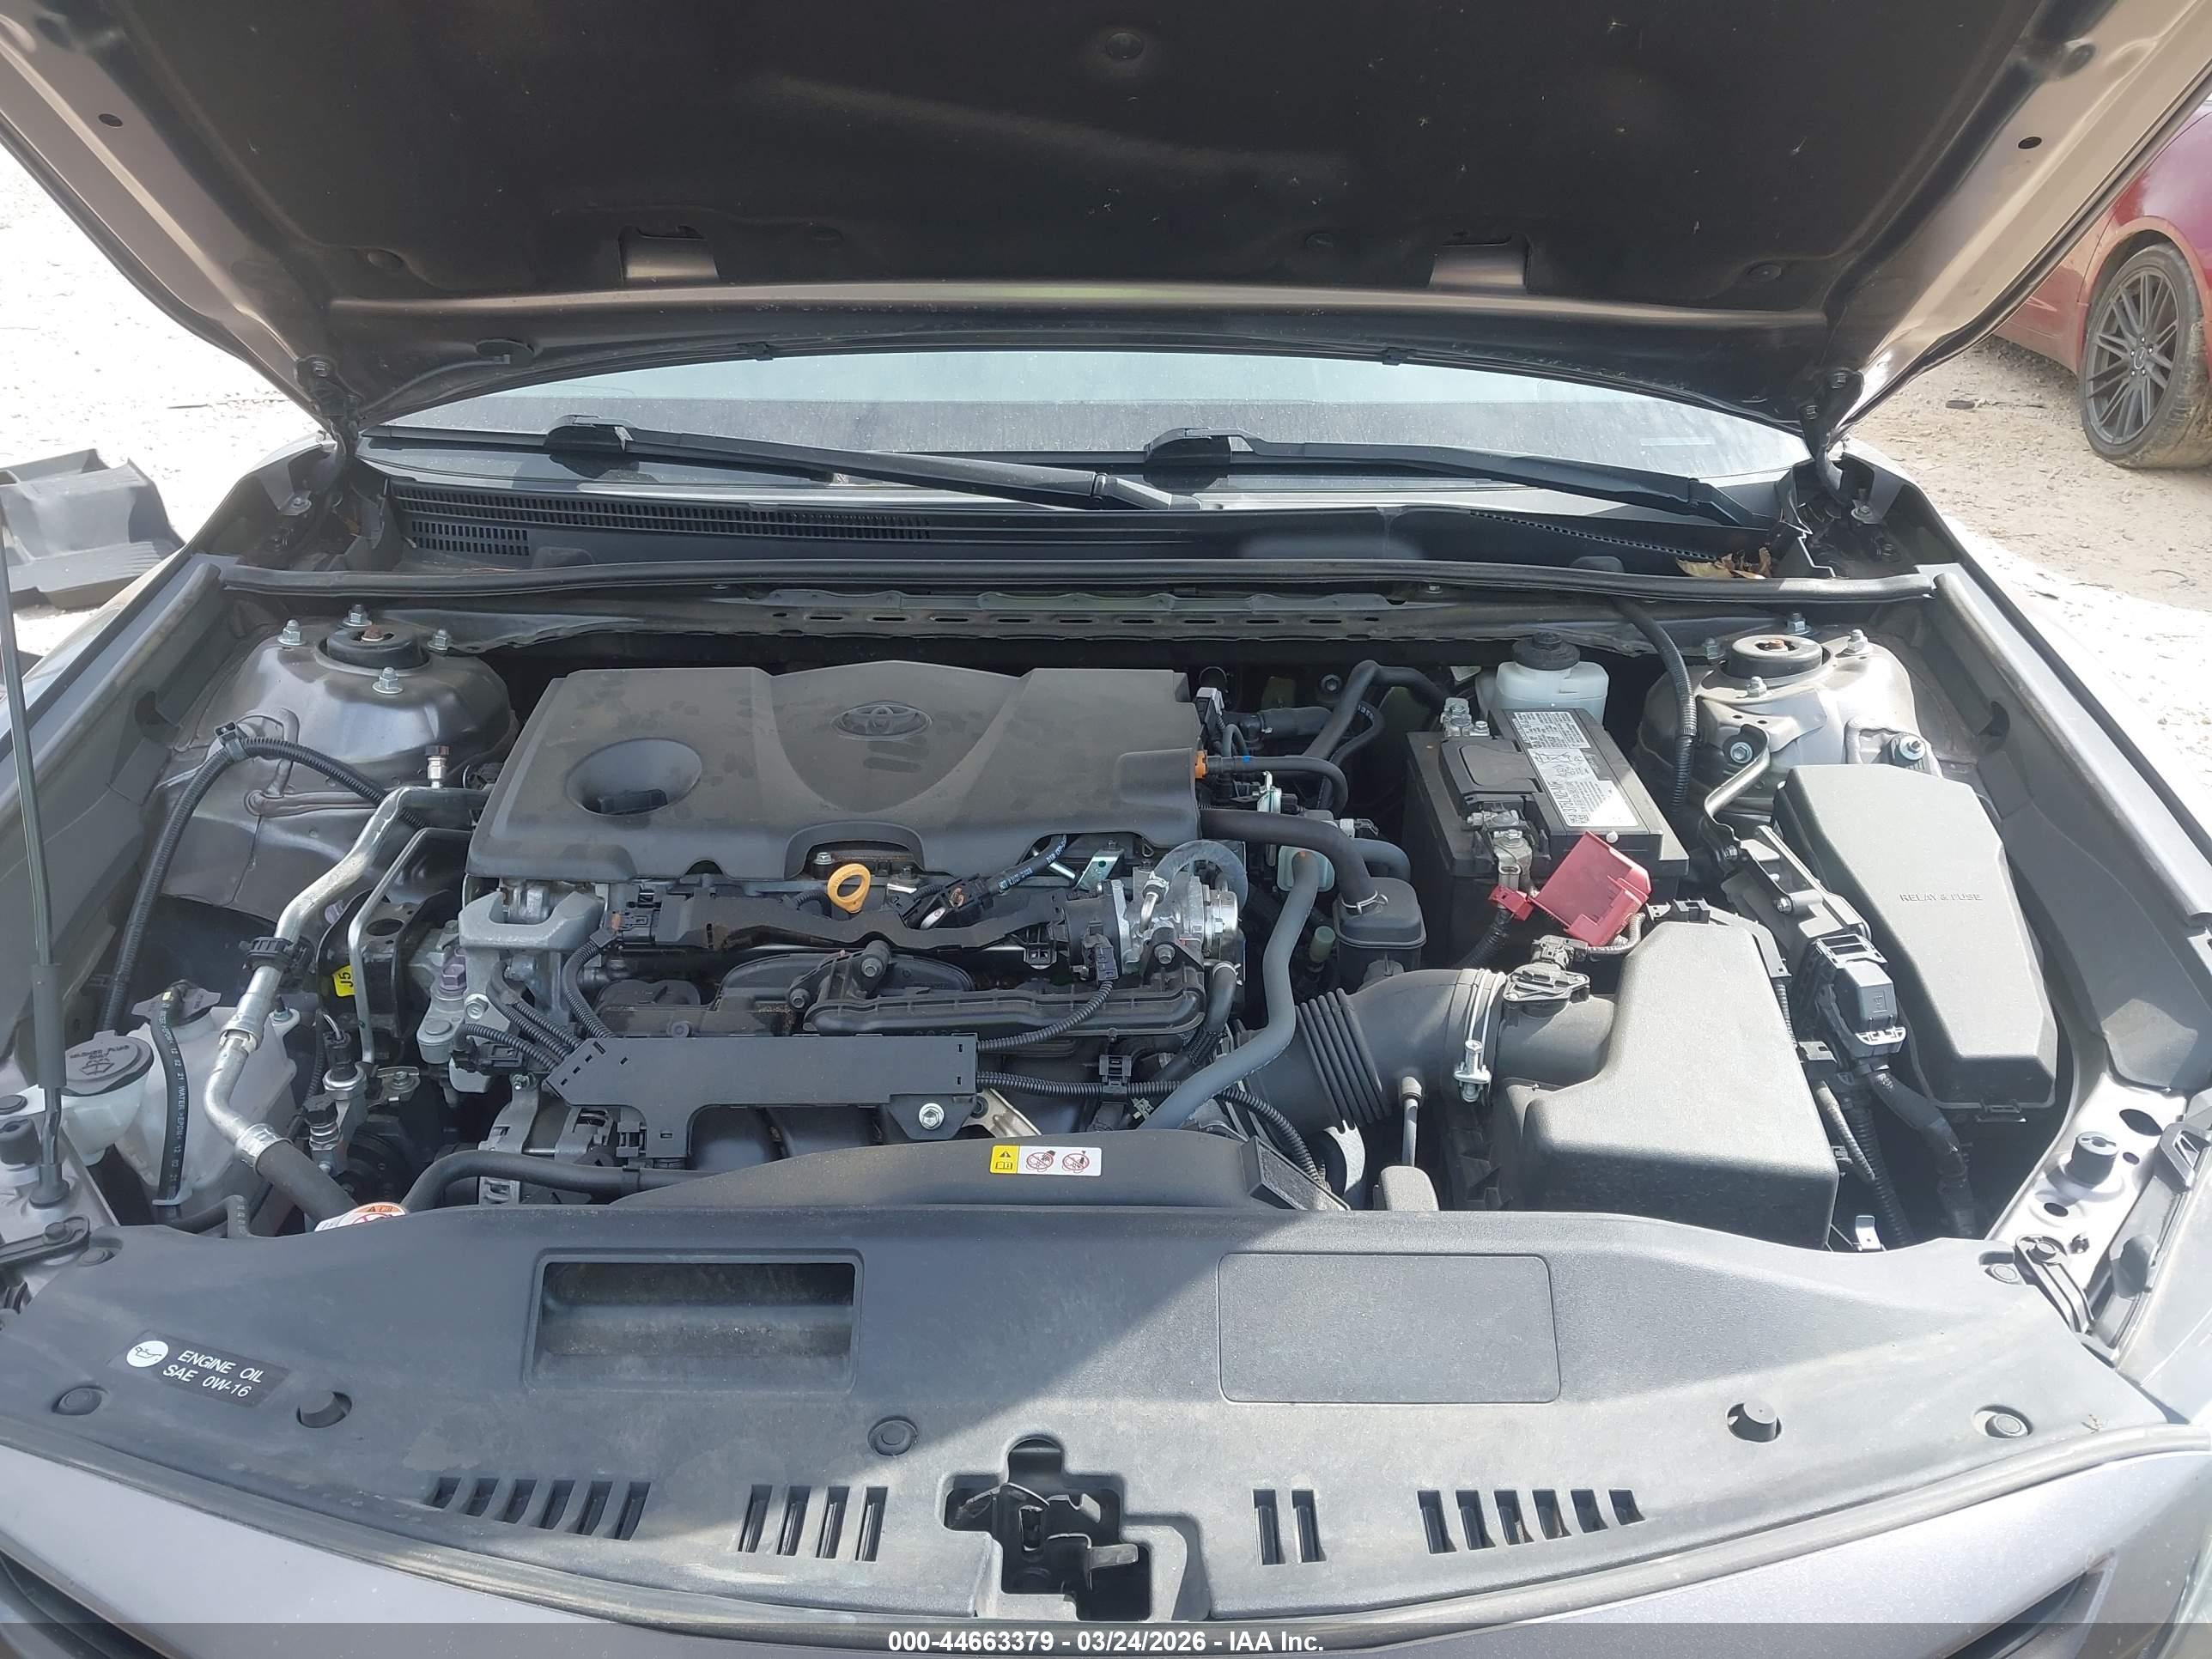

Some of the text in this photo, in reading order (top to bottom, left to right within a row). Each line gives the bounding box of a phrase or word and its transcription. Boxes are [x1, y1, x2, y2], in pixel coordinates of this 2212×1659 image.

[1899, 893, 1937, 902] RELAY
[337, 972, 354, 988] J5
[178, 1085, 186, 1110] WATER
[177, 1350, 264, 1383] ENGINE OIL
[162, 1364, 252, 1397] SAE 0W-16
